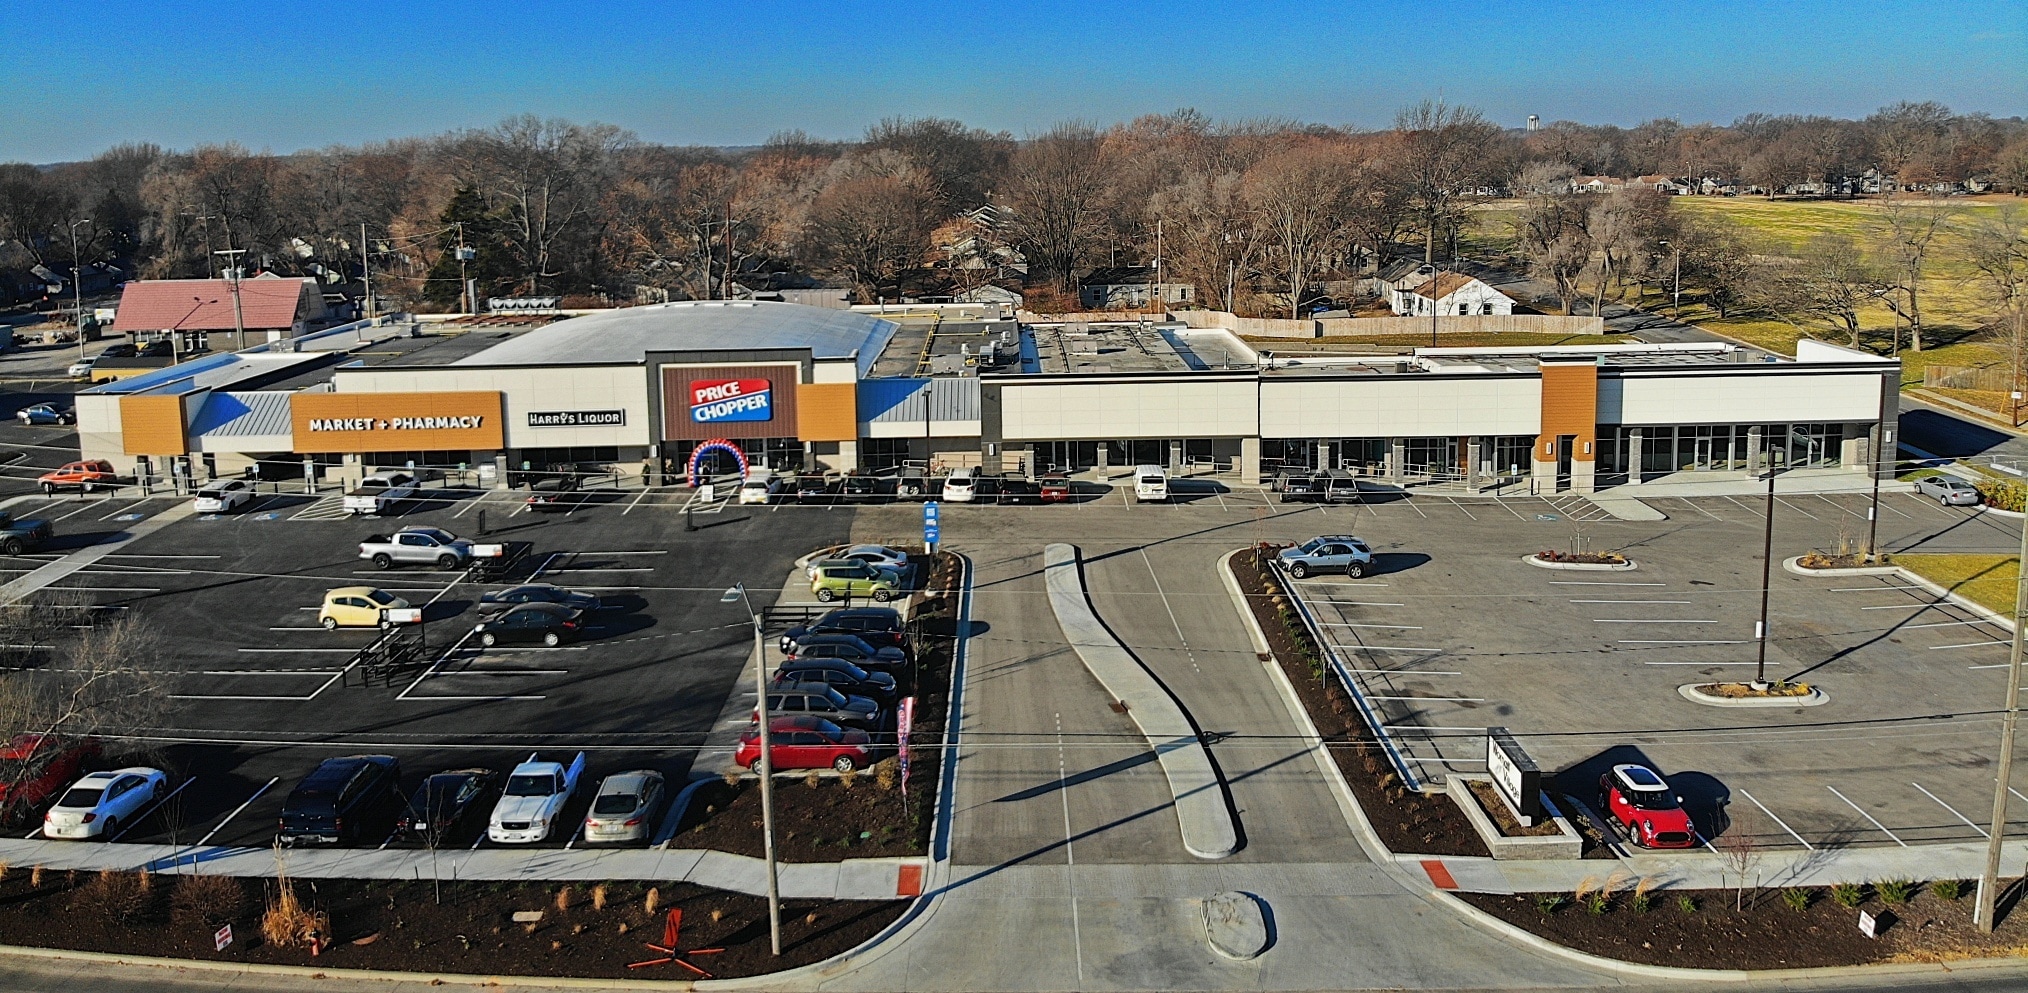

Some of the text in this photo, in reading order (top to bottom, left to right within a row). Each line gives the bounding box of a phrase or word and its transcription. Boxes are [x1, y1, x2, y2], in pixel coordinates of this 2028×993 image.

[695, 381, 741, 403] PRICE
[578, 411, 620, 424] LIQUOR
[695, 394, 768, 422] CHOPPER
[309, 418, 374, 431] MARKET
[393, 415, 482, 430] PHARMACY
